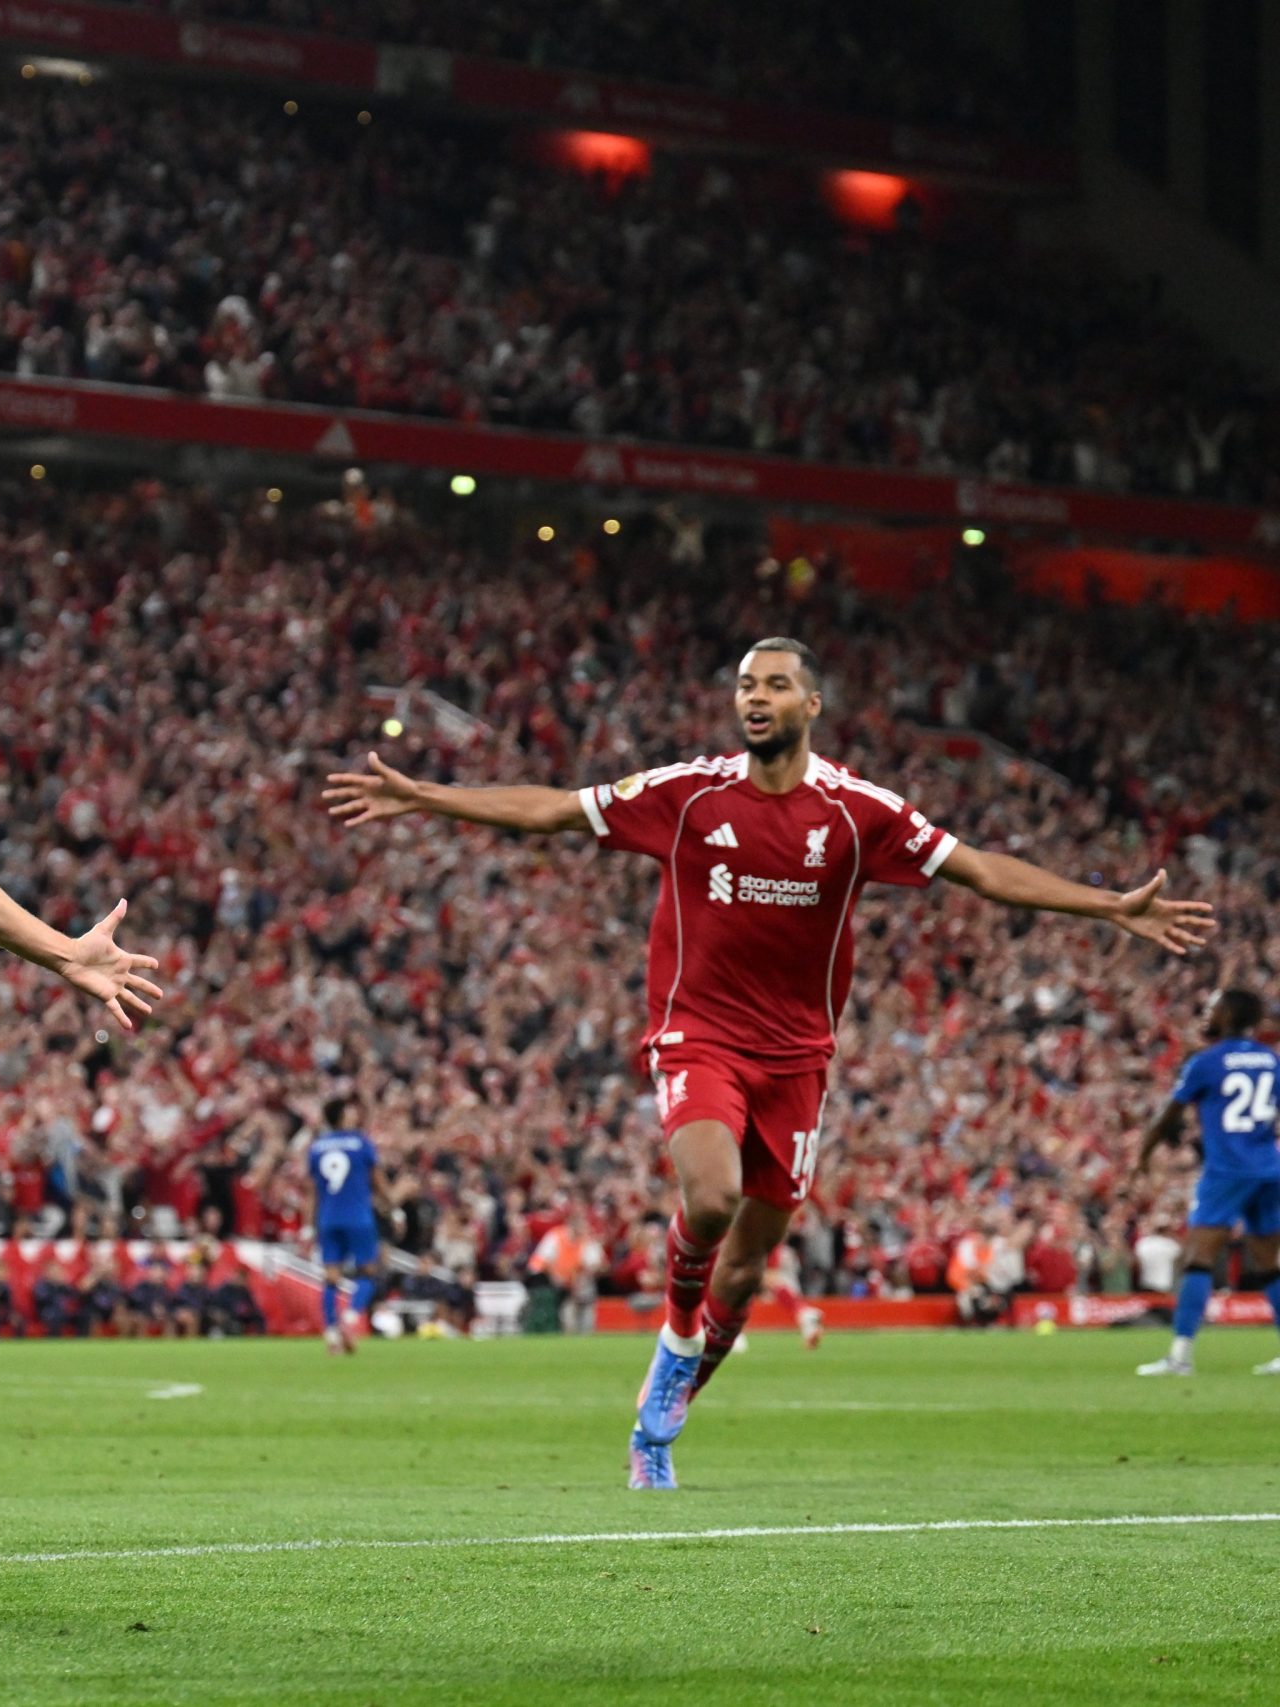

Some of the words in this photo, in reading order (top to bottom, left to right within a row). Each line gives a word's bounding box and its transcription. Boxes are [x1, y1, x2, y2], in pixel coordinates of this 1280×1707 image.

[737, 889, 821, 906] chartered
[739, 874, 818, 894] standard
[1221, 1071, 1277, 1132] 24
[320, 1150, 351, 1195] 9
